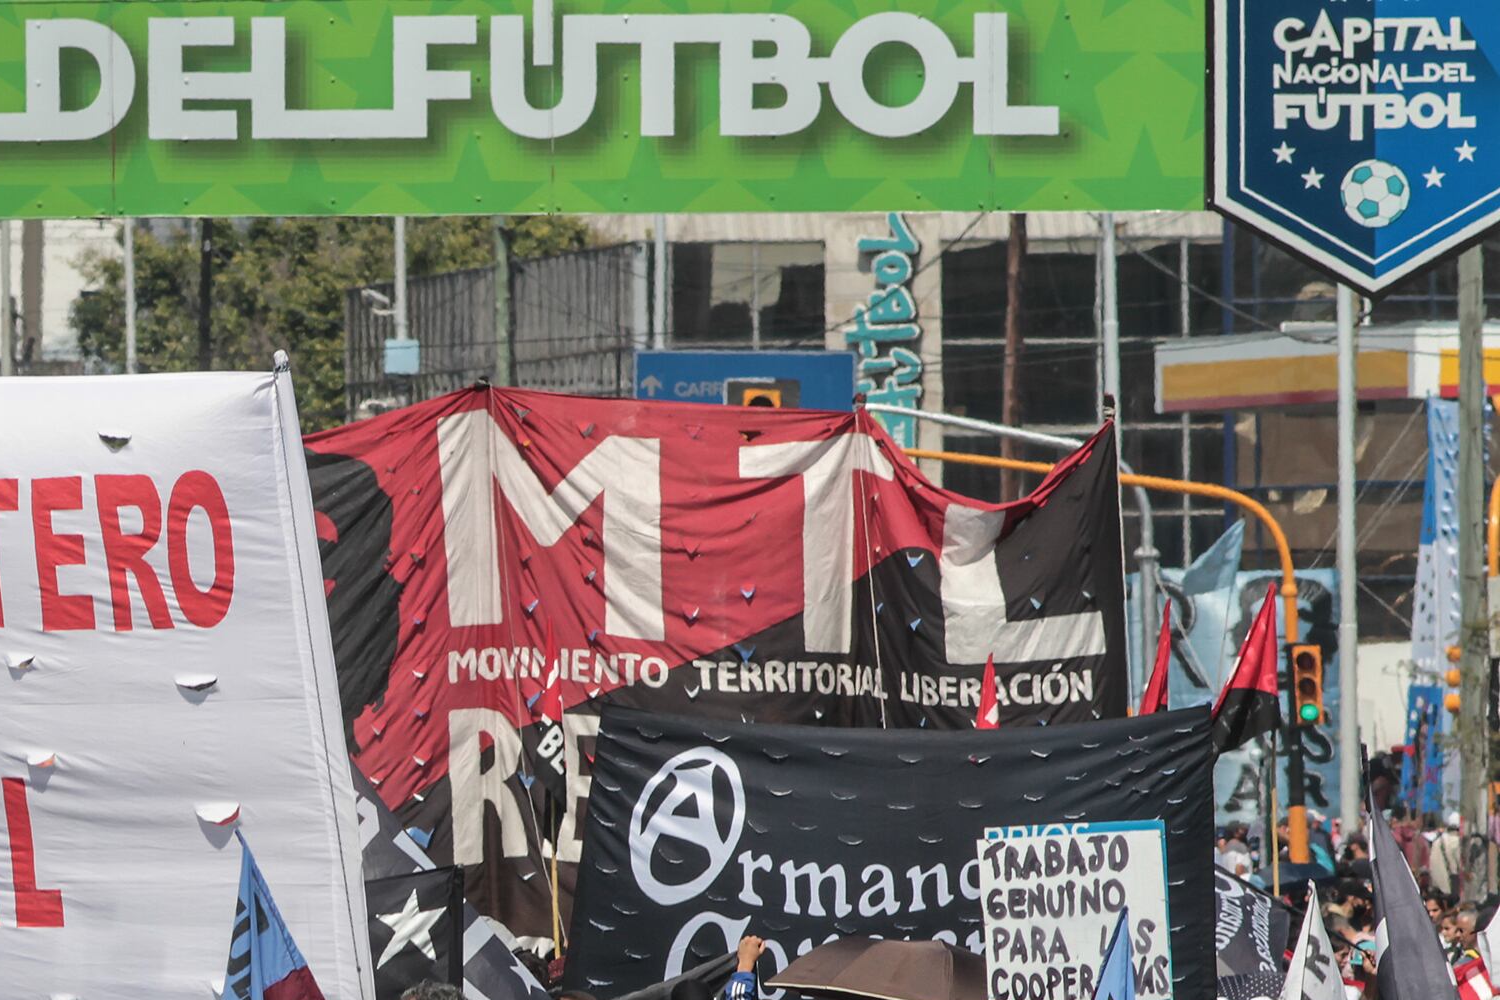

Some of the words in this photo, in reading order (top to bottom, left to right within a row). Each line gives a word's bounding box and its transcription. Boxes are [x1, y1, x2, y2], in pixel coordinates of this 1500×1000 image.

[1420, 62, 1475, 83] DEL
[437, 406, 1106, 665] MTL
[692, 659, 888, 700] TERRITORIAL
[983, 834, 1130, 882] TRABAJO
[986, 878, 1126, 920] GENUINO
[992, 926, 1070, 964] PARA
[1100, 918, 1156, 957] LS
